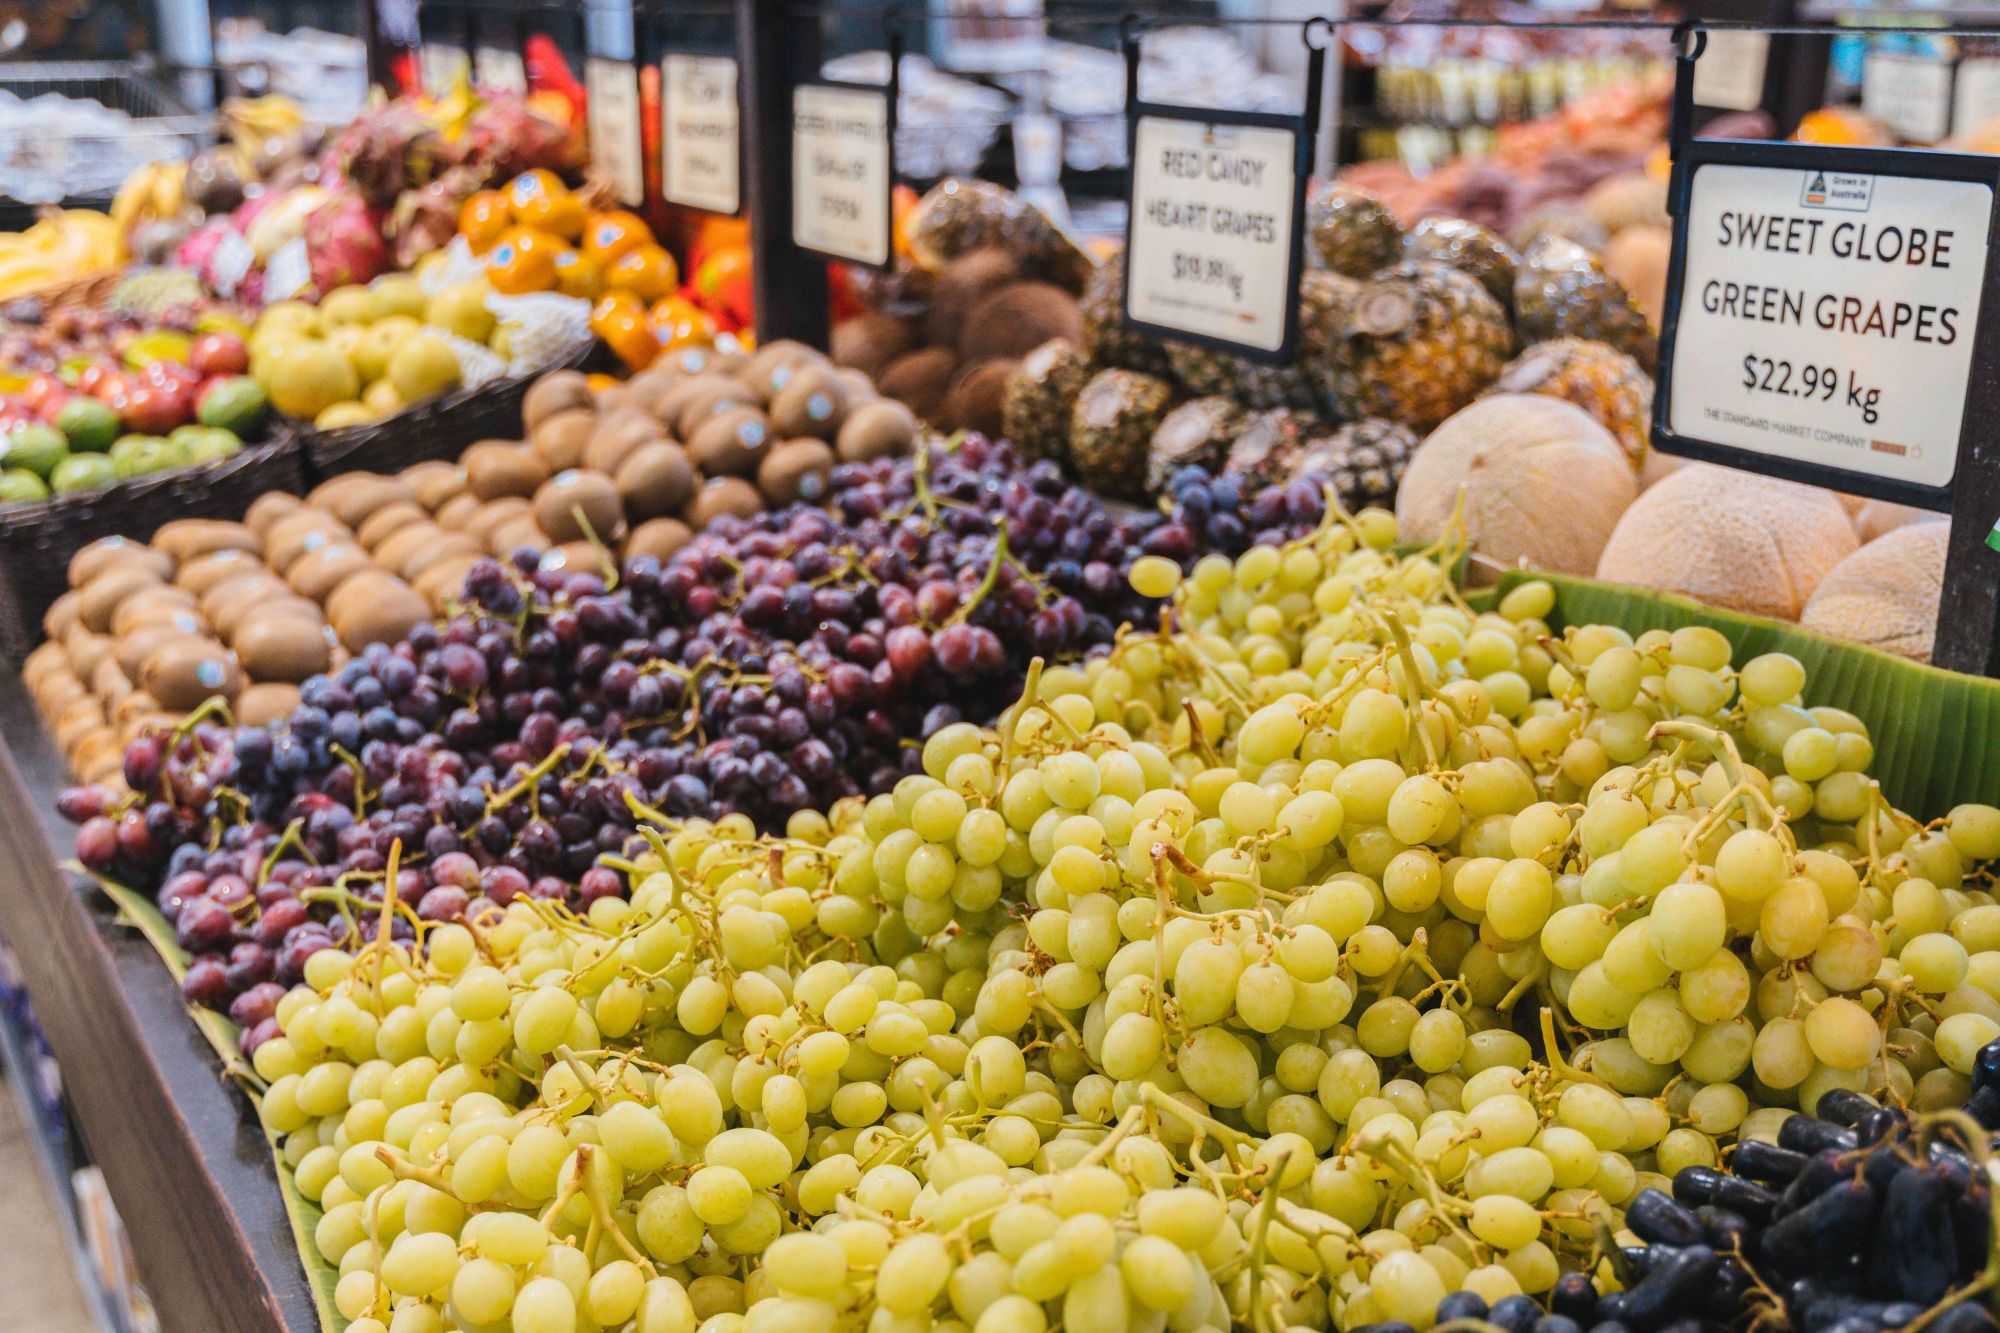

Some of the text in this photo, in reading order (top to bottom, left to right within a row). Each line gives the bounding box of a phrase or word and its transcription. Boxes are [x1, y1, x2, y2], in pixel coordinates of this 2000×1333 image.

[1161, 149, 1268, 187] RED CANDY
[1832, 175, 1858, 185] Grown
[1831, 190, 1866, 200] Australia
[1145, 198, 1277, 245] HEART GRAPES
[1718, 211, 1955, 269] SWEET GLOBE
[1702, 279, 1960, 346] GREEN GRAPES
[1742, 353, 1882, 425] $22.99 kg
[1704, 408, 1721, 421] THE
[1722, 412, 1770, 432] STANDARD
[1772, 423, 1814, 439] MARKET
[1813, 428, 1868, 449] COMPANY
